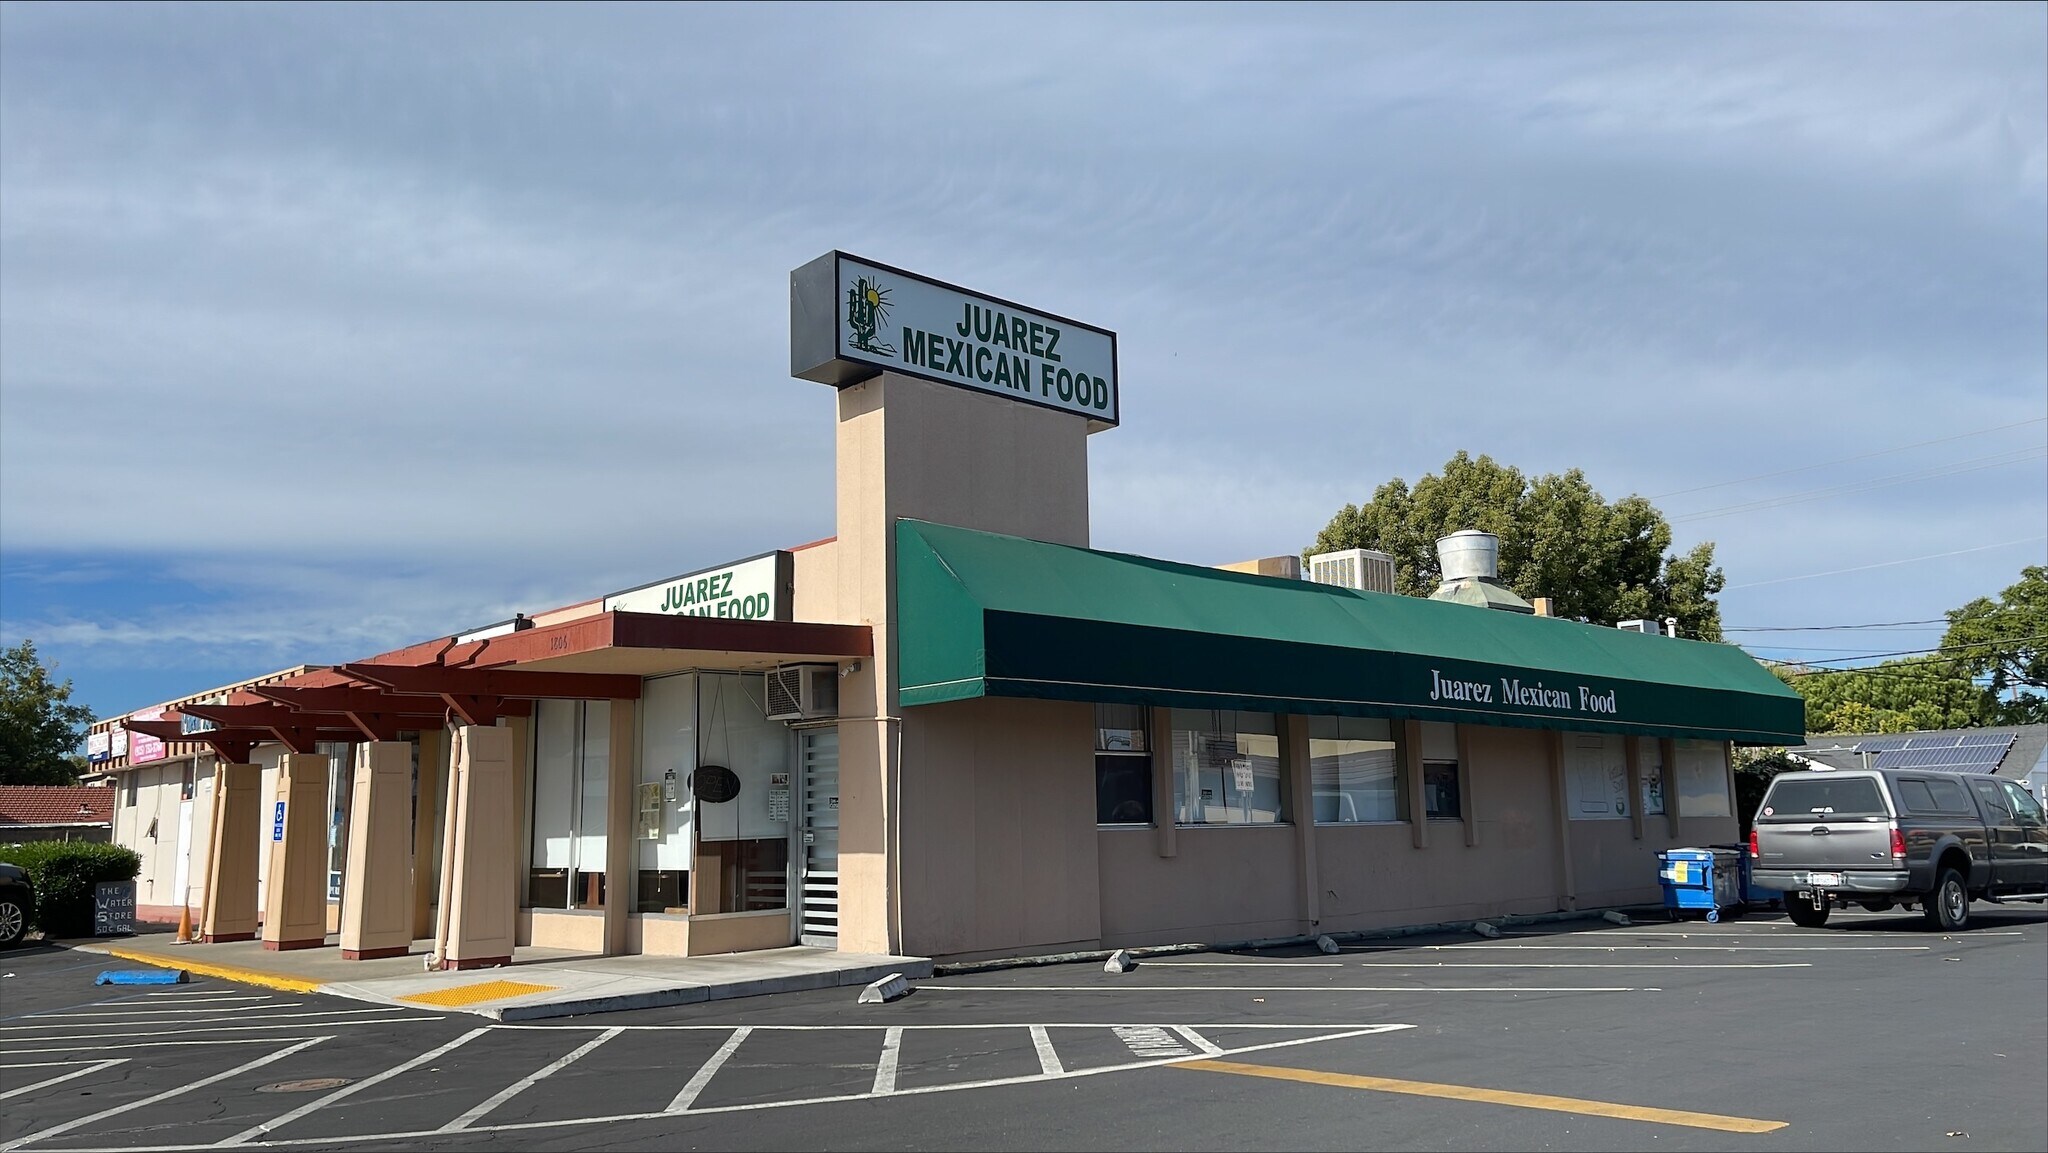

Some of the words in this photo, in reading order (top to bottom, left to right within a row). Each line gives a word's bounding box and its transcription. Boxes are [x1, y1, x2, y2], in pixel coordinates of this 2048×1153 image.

[956, 303, 1061, 362] JUAREZ
[903, 326, 1030, 392] MEXICAN
[1041, 363, 1109, 410] FOOD
[661, 572, 733, 612] JUAREZ
[717, 592, 770, 620] FOOD
[1430, 669, 1493, 703] Juarez
[1500, 678, 1572, 709] Mexican
[1578, 686, 1617, 714] Food
[96, 898, 133, 909] WATER
[101, 887, 120, 895] THE
[97, 911, 132, 922] STORE
[117, 924, 132, 932] GAL
